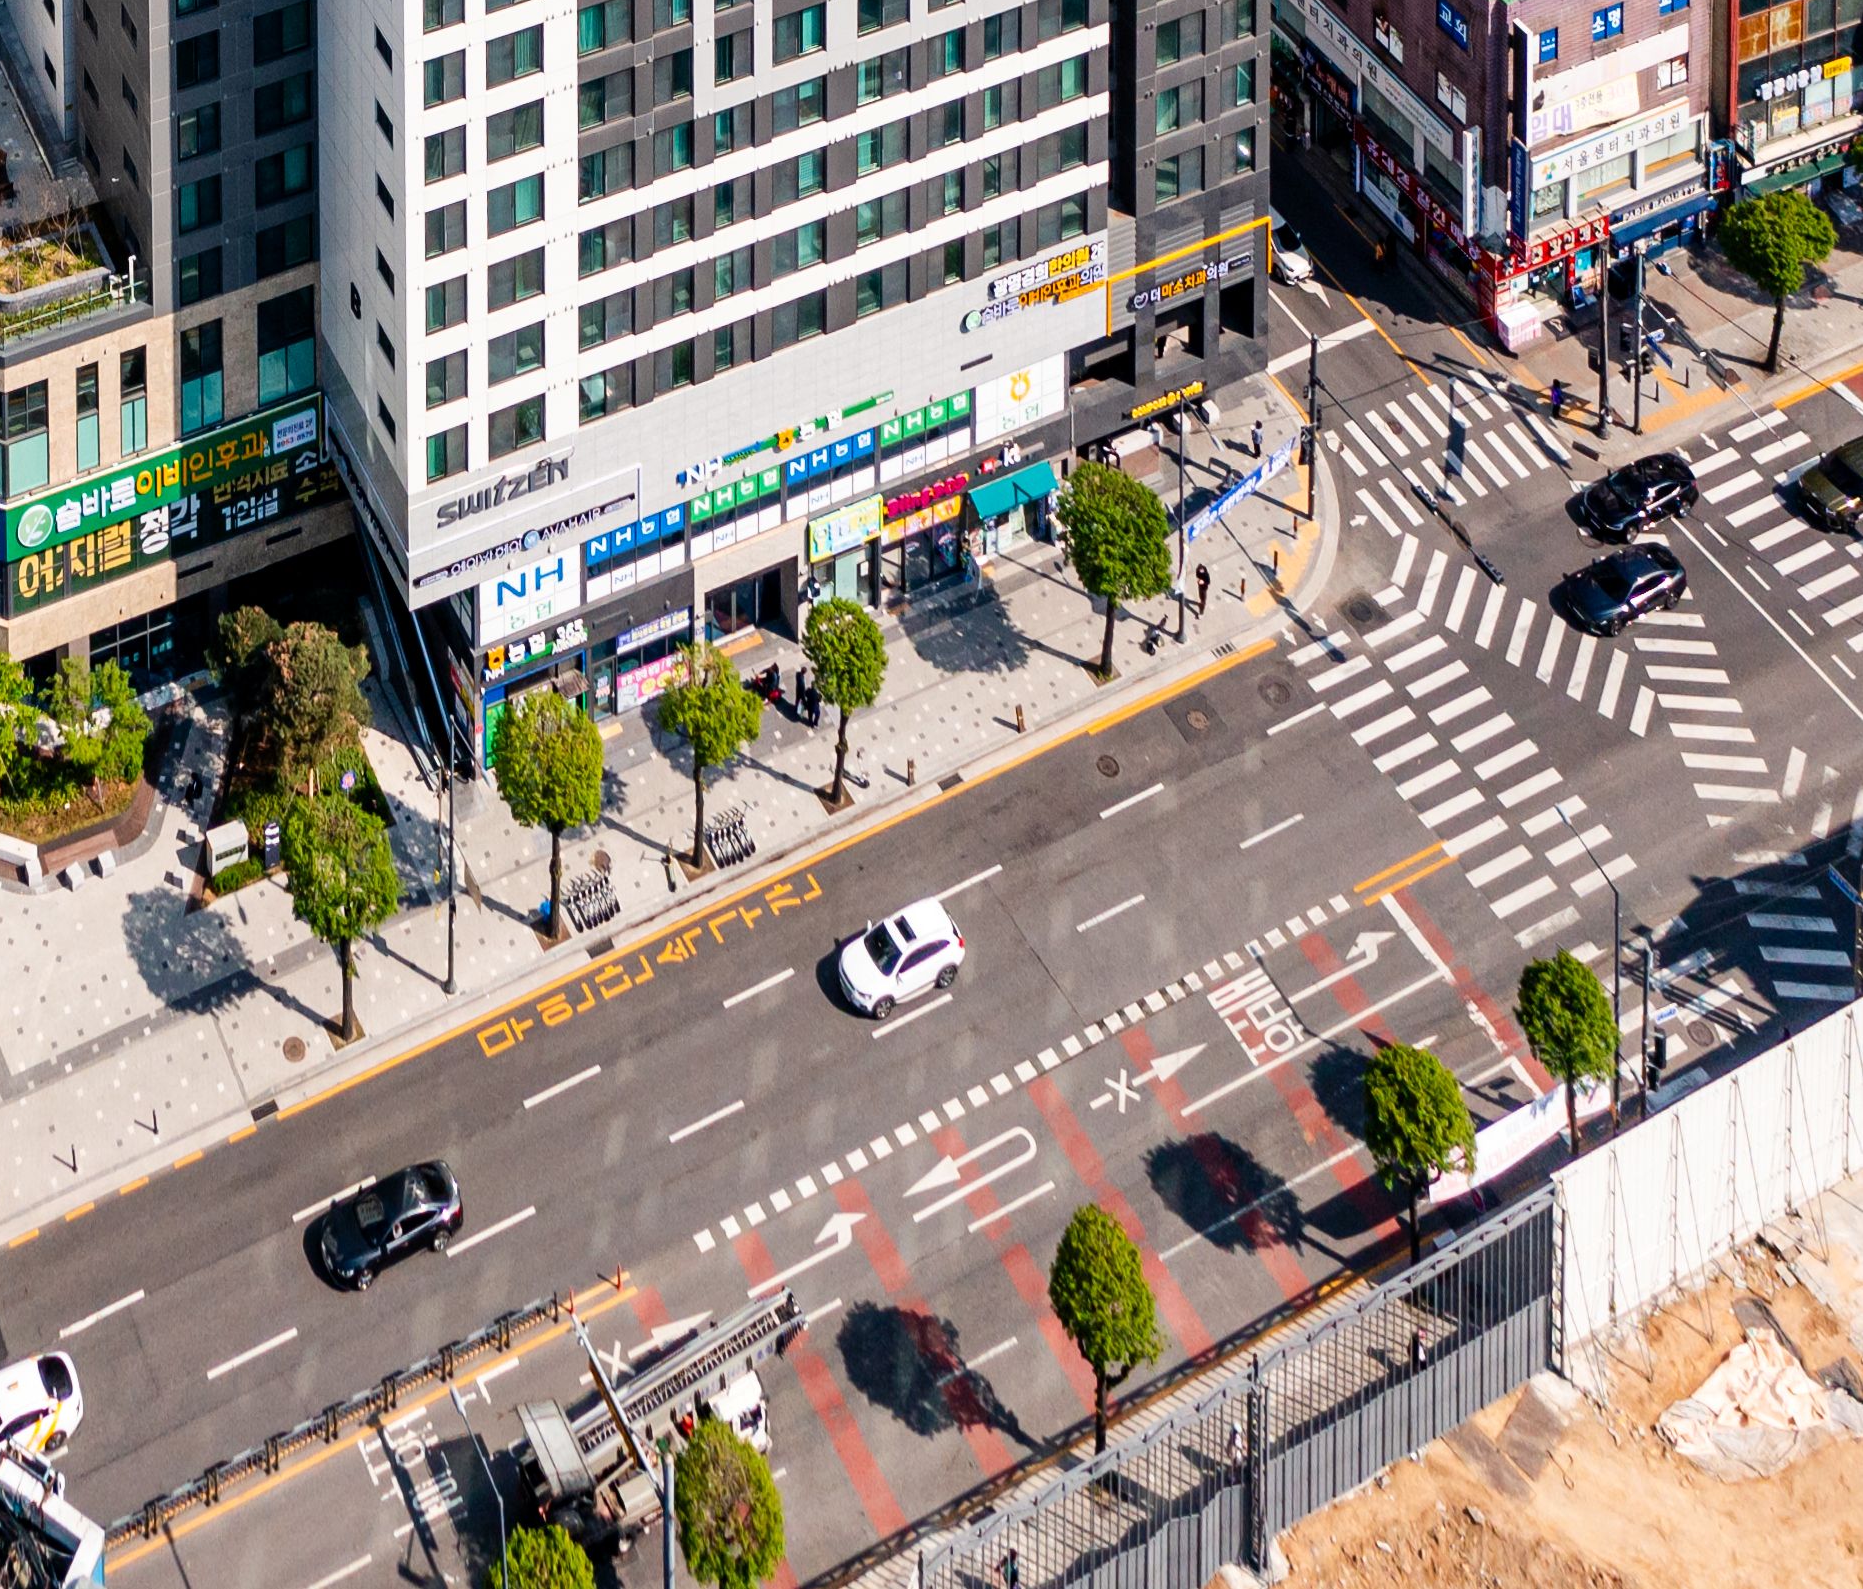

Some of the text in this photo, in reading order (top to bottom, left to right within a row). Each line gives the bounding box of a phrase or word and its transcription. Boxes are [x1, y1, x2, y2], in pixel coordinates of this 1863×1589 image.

[1439, 2, 1467, 43] 교회
[1592, 8, 1621, 34] 소명
[1532, 103, 1574, 139] 임대
[1563, 112, 1681, 172] 서울센터치과의원
[993, 245, 1089, 297] 광명경희한의원
[350, 281, 361, 319] B
[1003, 403, 1039, 430] 농협
[686, 455, 724, 485] NH
[498, 557, 564, 607] NH
[614, 571, 634, 585] NH
[510, 600, 552, 631] 농협
[476, 873, 823, 1058] 무인단속구간
[1206, 966, 1306, 1067] 비보호
